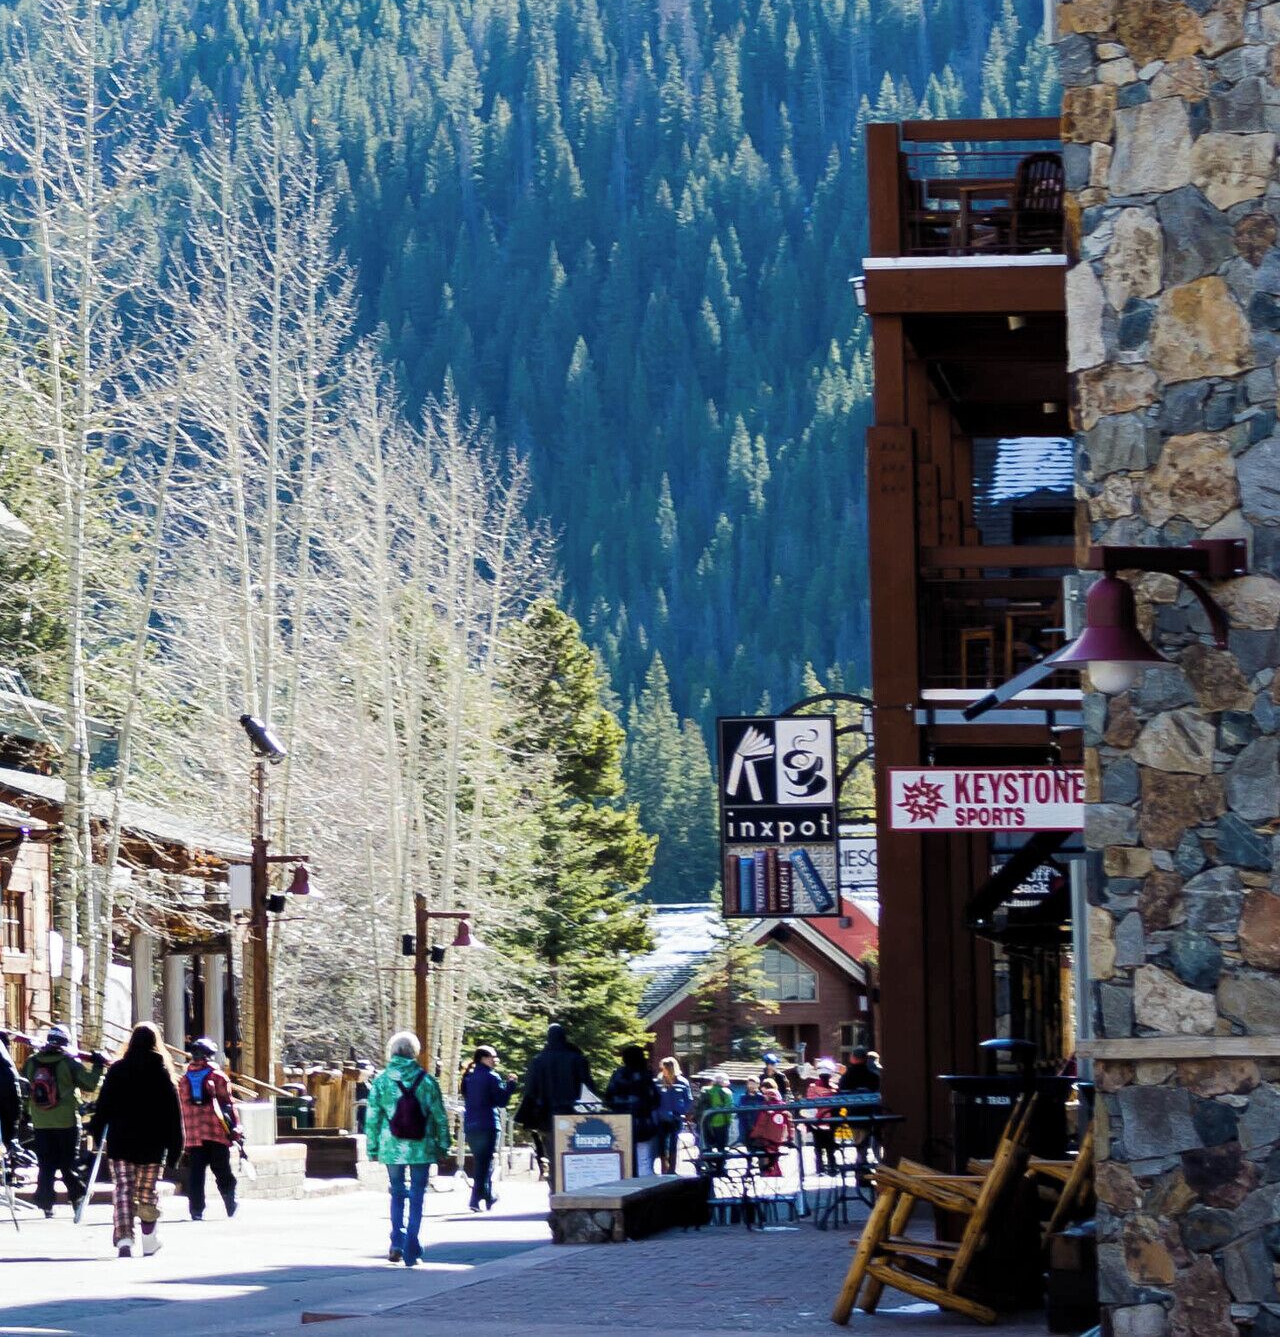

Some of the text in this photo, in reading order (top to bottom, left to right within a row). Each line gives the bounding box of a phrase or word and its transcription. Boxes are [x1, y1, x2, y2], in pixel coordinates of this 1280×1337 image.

[954, 772, 1084, 804] KEYSTONE
[727, 811, 831, 844] inxpot
[954, 806, 1026, 827] SPORTS
[780, 867, 789, 908] LUNCH
